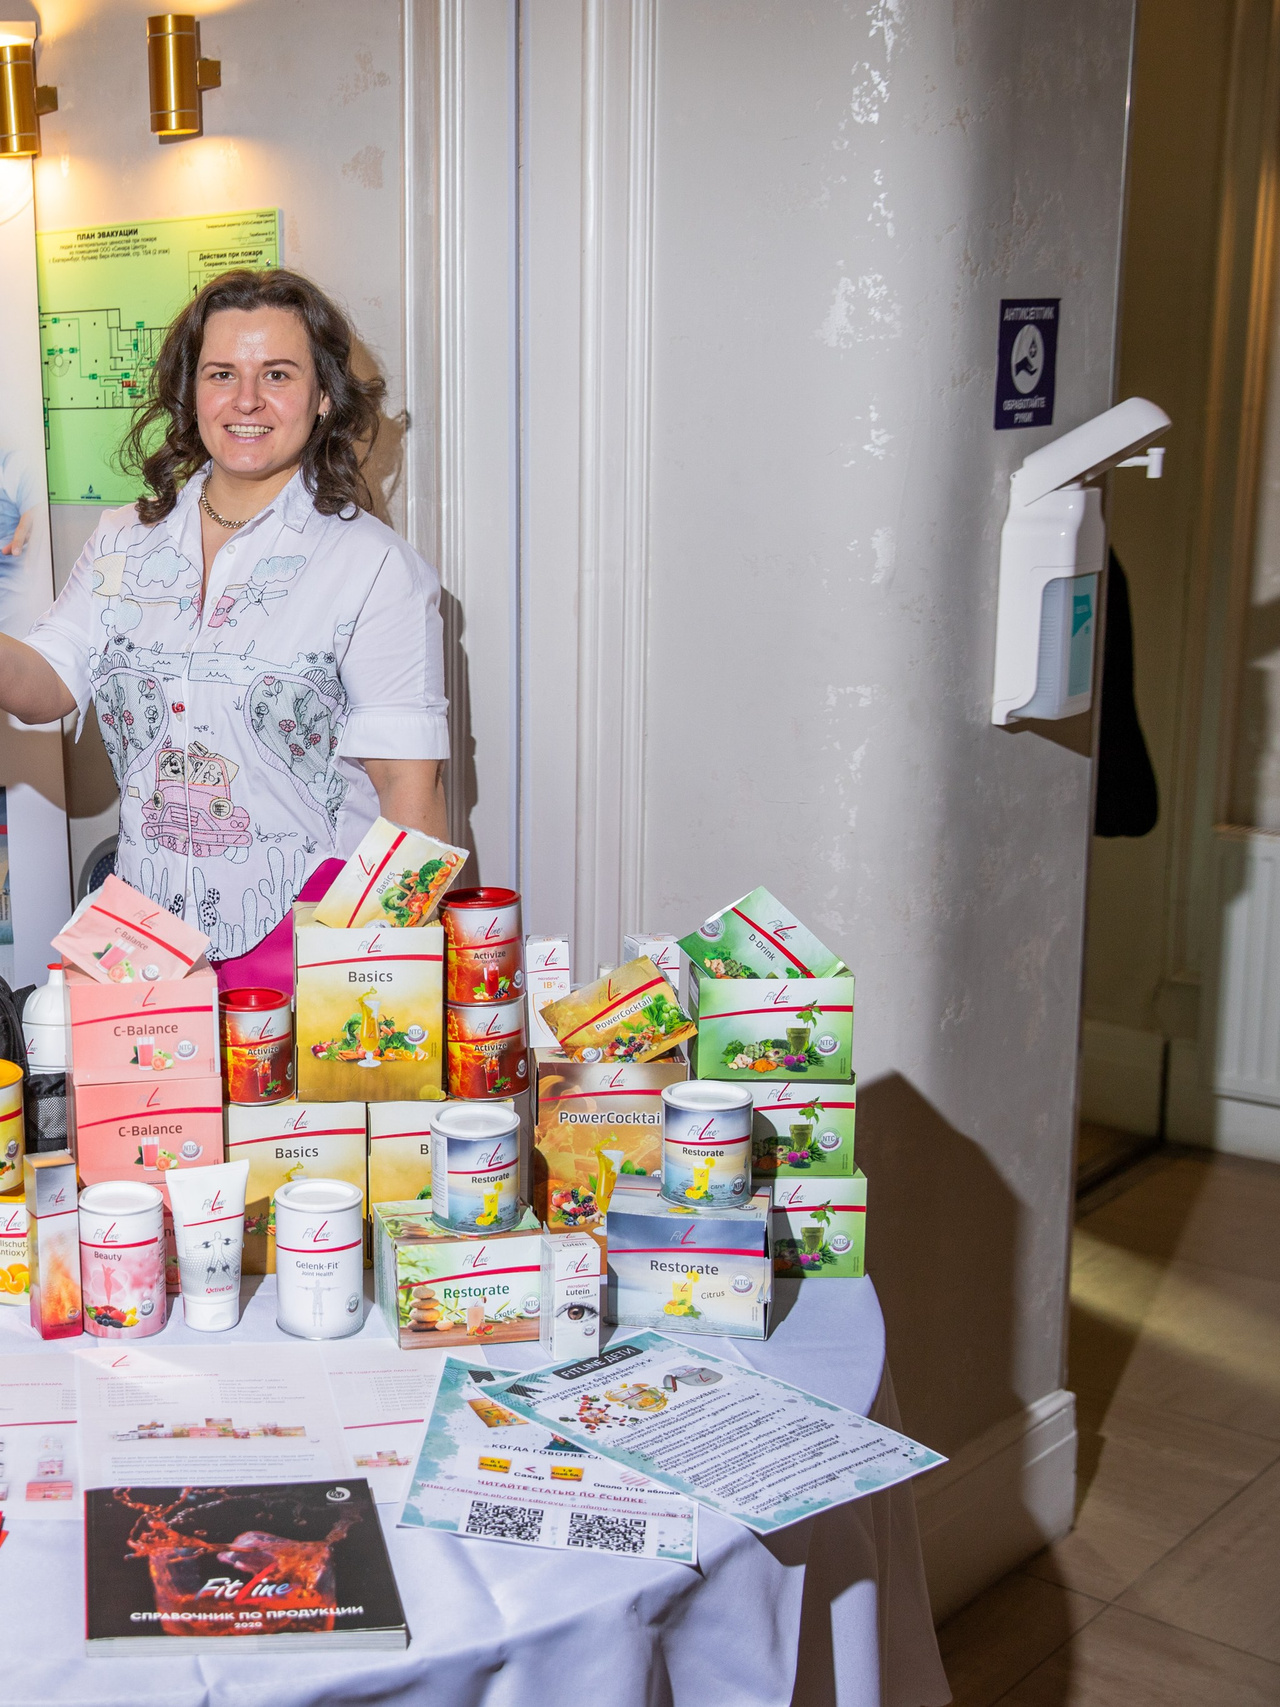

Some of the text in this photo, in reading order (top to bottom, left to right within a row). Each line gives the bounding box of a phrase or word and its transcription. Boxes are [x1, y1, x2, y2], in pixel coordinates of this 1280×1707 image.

[98, 229, 138, 238] ЭВАКУАЦИИ
[1004, 306, 1055, 321] АНТИСЕПТИК
[376, 870, 396, 896] Basics
[474, 917, 503, 940] FitLine
[767, 919, 797, 941] FitLine
[114, 926, 149, 951] C-Balance
[358, 934, 385, 953] FitLine
[473, 950, 506, 960] Activize
[749, 933, 776, 961] D-Drink
[348, 971, 393, 983] Basics
[764, 985, 792, 1004] FitLine
[595, 996, 653, 1032] PowerCocktail
[113, 1023, 179, 1037] C-Balance
[475, 1013, 503, 1036] FitLine
[178, 1044, 192, 1052] NTC
[247, 1045, 279, 1057] Activize
[474, 1042, 507, 1053] Activize
[600, 1068, 627, 1088] FitLine
[767, 1082, 795, 1101] FitLine
[284, 1111, 310, 1130] FitLine
[559, 1112, 660, 1126] PowerCocktai
[118, 1123, 183, 1137] C-Balance
[687, 1118, 720, 1140] FitLine
[275, 1147, 319, 1159] Basics
[477, 1143, 506, 1167] FitLine
[682, 1147, 724, 1157] Restorate
[472, 1172, 510, 1184] Restorate
[202, 1190, 226, 1211] FitLine
[779, 1185, 806, 1205] FitLine
[94, 1222, 120, 1243] FitLine
[302, 1220, 333, 1243] FitLine
[94, 1251, 122, 1262] Beauty
[462, 1246, 490, 1268] FitLine
[566, 1253, 591, 1273] FitLine
[650, 1260, 719, 1276] Restorate
[206, 1286, 220, 1294] Active
[444, 1284, 510, 1299] Restorate
[565, 1288, 590, 1296] Lutein
[701, 1289, 725, 1300] Citrus
[494, 1308, 517, 1320] Exotic
[561, 1348, 635, 1378] FITLINE ДЕТИ
[542, 1382, 587, 1402] подготовки
[593, 1361, 644, 1382] беременности
[560, 1390, 581, 1400] детям
[627, 1409, 669, 1428] ПРОГРАММА
[491, 1443, 584, 1459] КОГДА ГОВОРЯТ
[514, 1472, 544, 1481] Сахар
[478, 1480, 528, 1490] ЧИТАЙТЕ
[531, 1487, 575, 1497] СТАТЬЮ
[600, 1493, 647, 1504] ССЫЛКЕ:
[593, 1482, 623, 1490] Около
[195, 1562, 293, 1605] FitLine
[130, 1606, 364, 1622] СПРАВОЧНИК ПО ПРОДУКЦИИ
[234, 1621, 263, 1629] 2020
